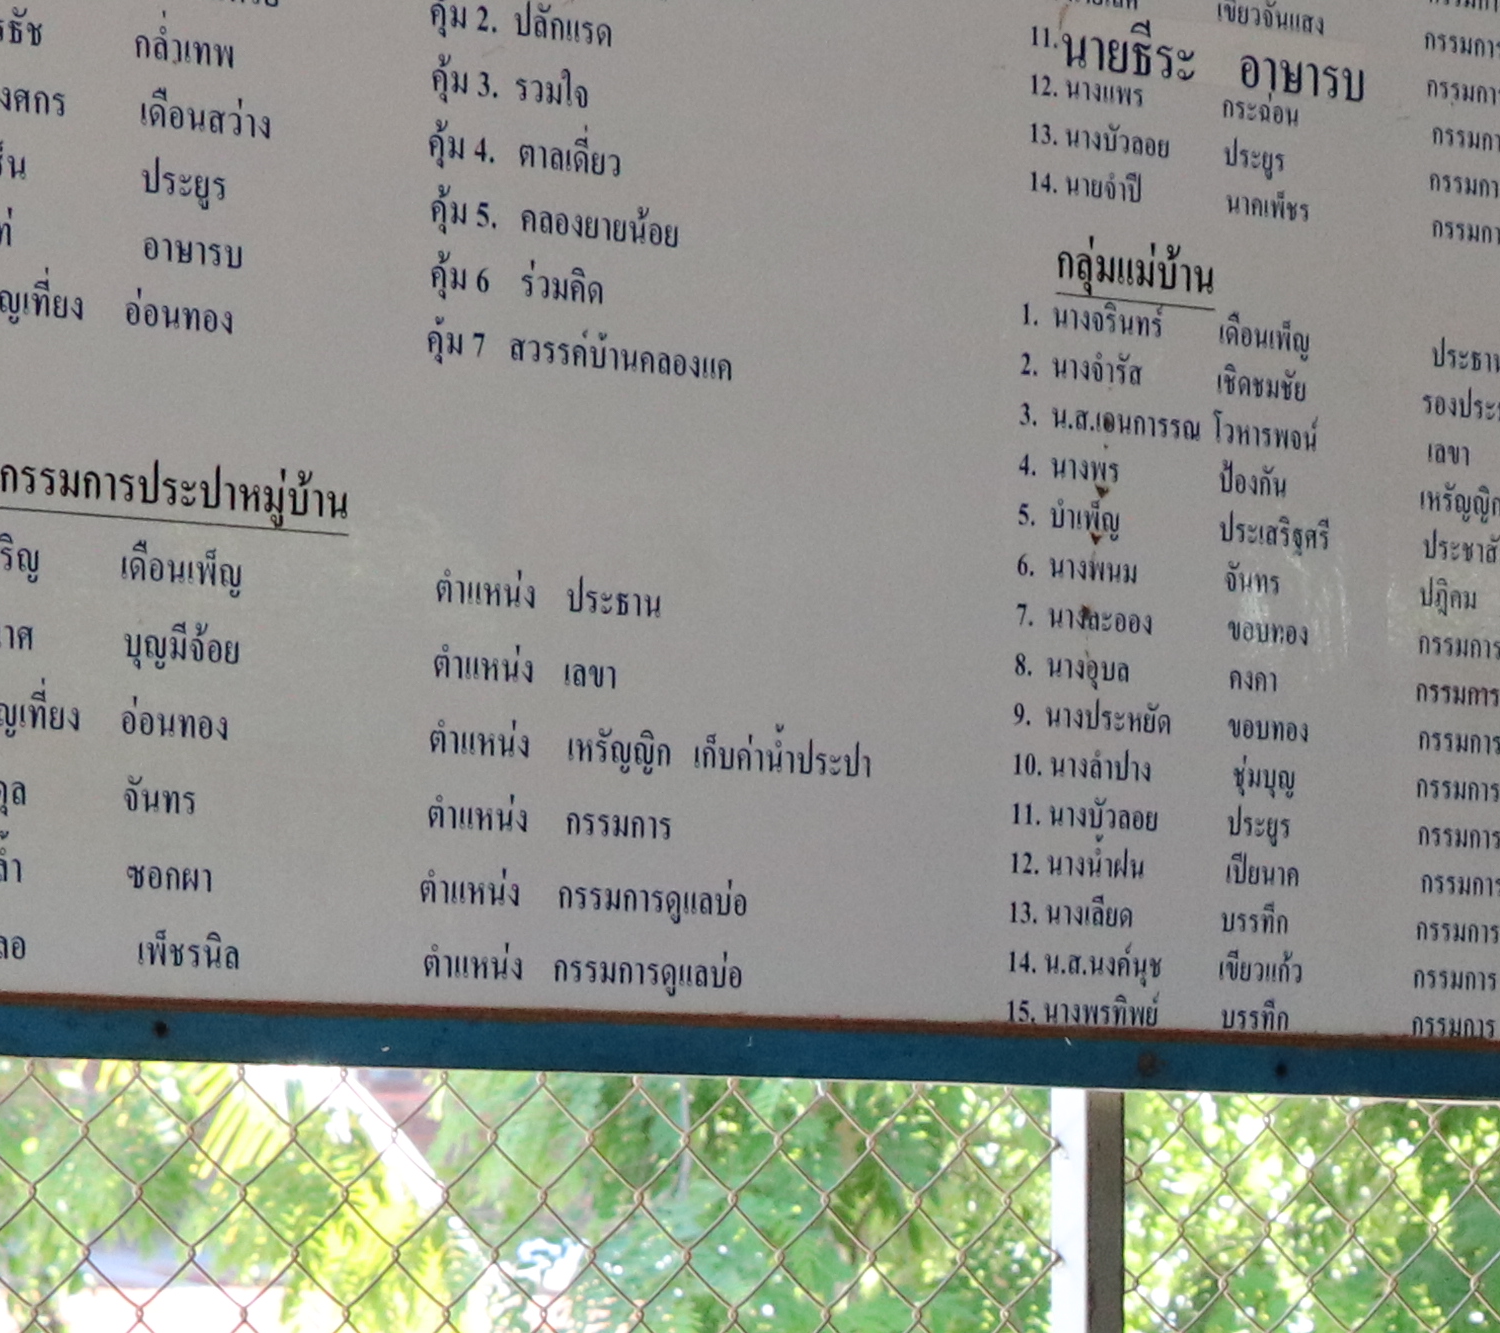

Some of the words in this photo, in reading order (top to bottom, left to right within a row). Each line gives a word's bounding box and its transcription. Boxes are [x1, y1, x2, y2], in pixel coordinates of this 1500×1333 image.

[134, 10, 234, 69] กล่ำเทพ
[476, 5, 497, 34] 2.
[431, 53, 468, 104] คุ้ม
[477, 71, 498, 99] 3.
[515, 68, 589, 109] รวมใจ
[1061, 19, 1195, 82] นายธีระ
[1240, 54, 1365, 102] อาษารบ
[140, 87, 271, 140] เดือนสว่าง
[1066, 80, 1143, 107] นางแพร
[1222, 94, 1299, 126] กระฉ่อน
[428, 119, 465, 169] คุ้ม
[473, 137, 495, 164] 4.
[518, 125, 621, 178] ตาลเดี่ยว
[1065, 123, 1170, 159] นางบัวลอย
[1224, 137, 1284, 181] ประยูร
[141, 156, 226, 211] ประยูร
[1065, 172, 1142, 203] นายจำปี
[1226, 191, 1309, 222] นาคเพ็ชร
[430, 184, 467, 235] คุ้ม
[476, 201, 497, 230] 5.
[521, 206, 679, 248] คลองยายน้อย
[143, 236, 243, 270] อาษารบ
[430, 250, 467, 301] คุ้ม
[476, 268, 490, 294] 6
[521, 259, 604, 305] ร่วมคิด
[1056, 236, 1216, 296] กลุ่มแม่บ้าน
[125, 287, 233, 335] อ่อนทอง
[1053, 300, 1165, 338] นางจรินทร์
[1219, 311, 1310, 362] เดือนเพ็ญ
[427, 316, 463, 365] คุ้ม
[472, 332, 486, 357] 7
[510, 329, 733, 382] สวรรค์บ้านคลองแค
[1052, 352, 1142, 386] นางจำรัส
[1217, 363, 1306, 403] เชิดชมชัย
[1212, 409, 1318, 452] โวหารพจน์
[1427, 443, 1470, 466] เลขา
[1051, 457, 1119, 485] นางพร
[1219, 459, 1287, 498] ป้องกัน
[121, 539, 242, 599] เดือนเพ็ญ
[435, 568, 536, 609] ตำแหน่ง
[567, 575, 661, 618] ประธาน
[1049, 552, 1137, 584] นางพนม
[1225, 561, 1280, 595] จันทร
[124, 621, 240, 670] บุญมีจ้อย
[433, 643, 534, 684] ตำแหน่ง
[564, 663, 617, 690] เลขา
[1227, 620, 1309, 646] ขอบทอง
[1047, 650, 1130, 691] นางอุบล
[1229, 669, 1277, 692] คงคา
[121, 695, 228, 741] อ่อนทอง
[429, 719, 530, 759] ตำแหน่ง
[568, 728, 671, 776] เหรัญญิก
[694, 723, 871, 778] เก็บค่าน้ำประปา
[1045, 698, 1171, 735] นางประหยัด
[1227, 718, 1309, 743] ขอบทอง
[1050, 749, 1152, 783] นางลำปาง
[1233, 754, 1295, 800] ชุ่มบุญ
[1416, 778, 1500, 803] กรรมการ
[123, 775, 195, 815] จันทร
[427, 793, 528, 833] ตำแหน่ง
[566, 812, 671, 840] กรรมการ
[1049, 797, 1158, 832] นางบัวลอย
[1047, 834, 1144, 879] นางน้ำฝน
[1226, 852, 1299, 887] เปียนาค
[419, 867, 520, 907] ตำแหน่ง
[558, 878, 748, 925] กรรมการดูแลบ่อ
[138, 929, 240, 970] เพ็ชรนิล
[423, 942, 523, 981] ตำแหน่ง
[554, 950, 743, 997] กรรมการดูแลบ่อ
[1044, 943, 1162, 988] น.ส.นงค์นุช
[1219, 949, 1303, 984] เขียวแก้ว
